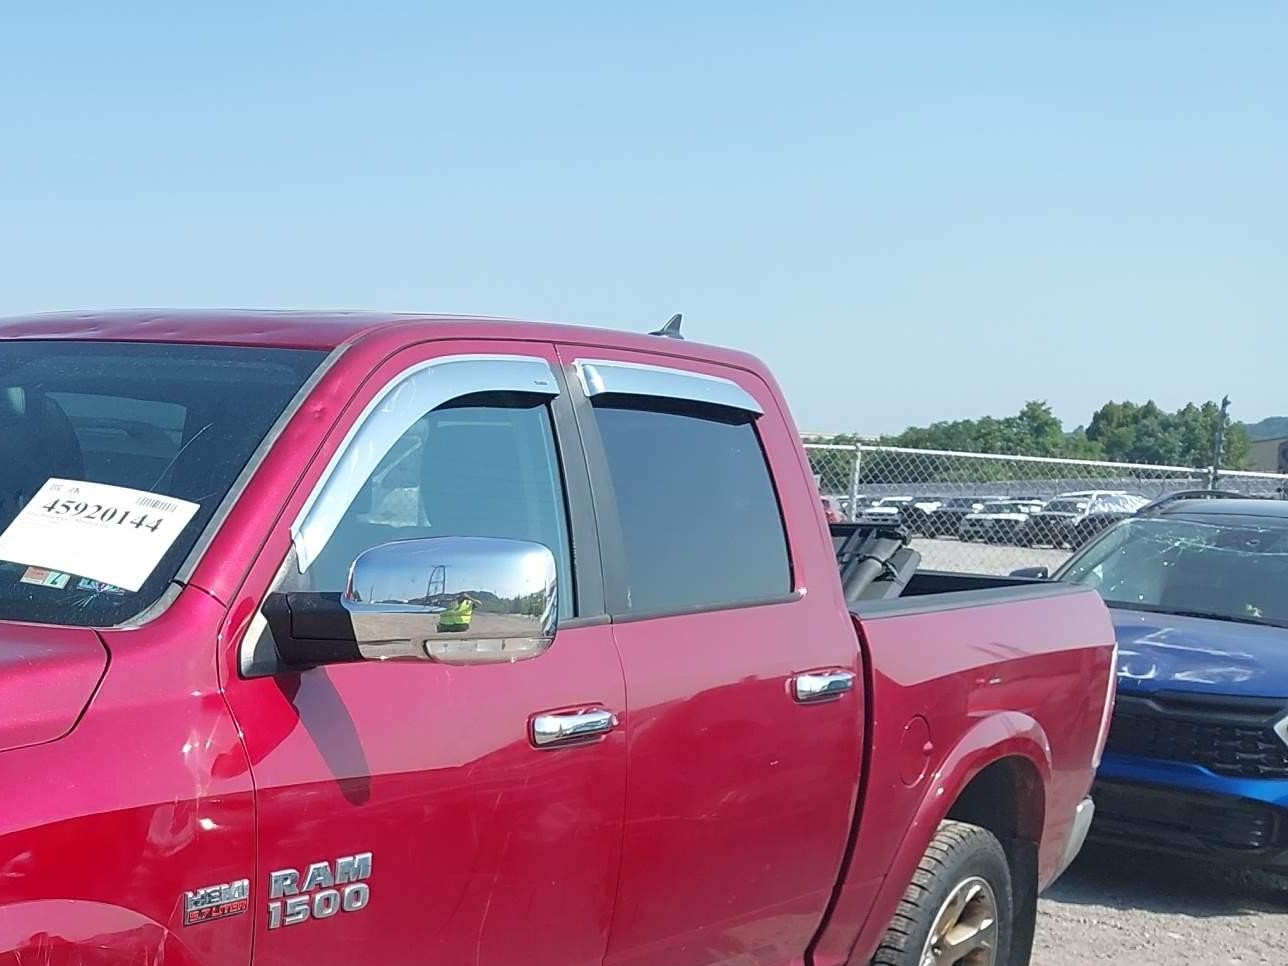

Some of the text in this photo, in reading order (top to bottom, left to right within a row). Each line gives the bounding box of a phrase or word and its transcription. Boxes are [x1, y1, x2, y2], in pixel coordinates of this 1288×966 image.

[42, 498, 164, 532] 45920144
[186, 879, 249, 909] HEMI
[270, 852, 373, 899] RAM
[269, 882, 369, 929] 1500
